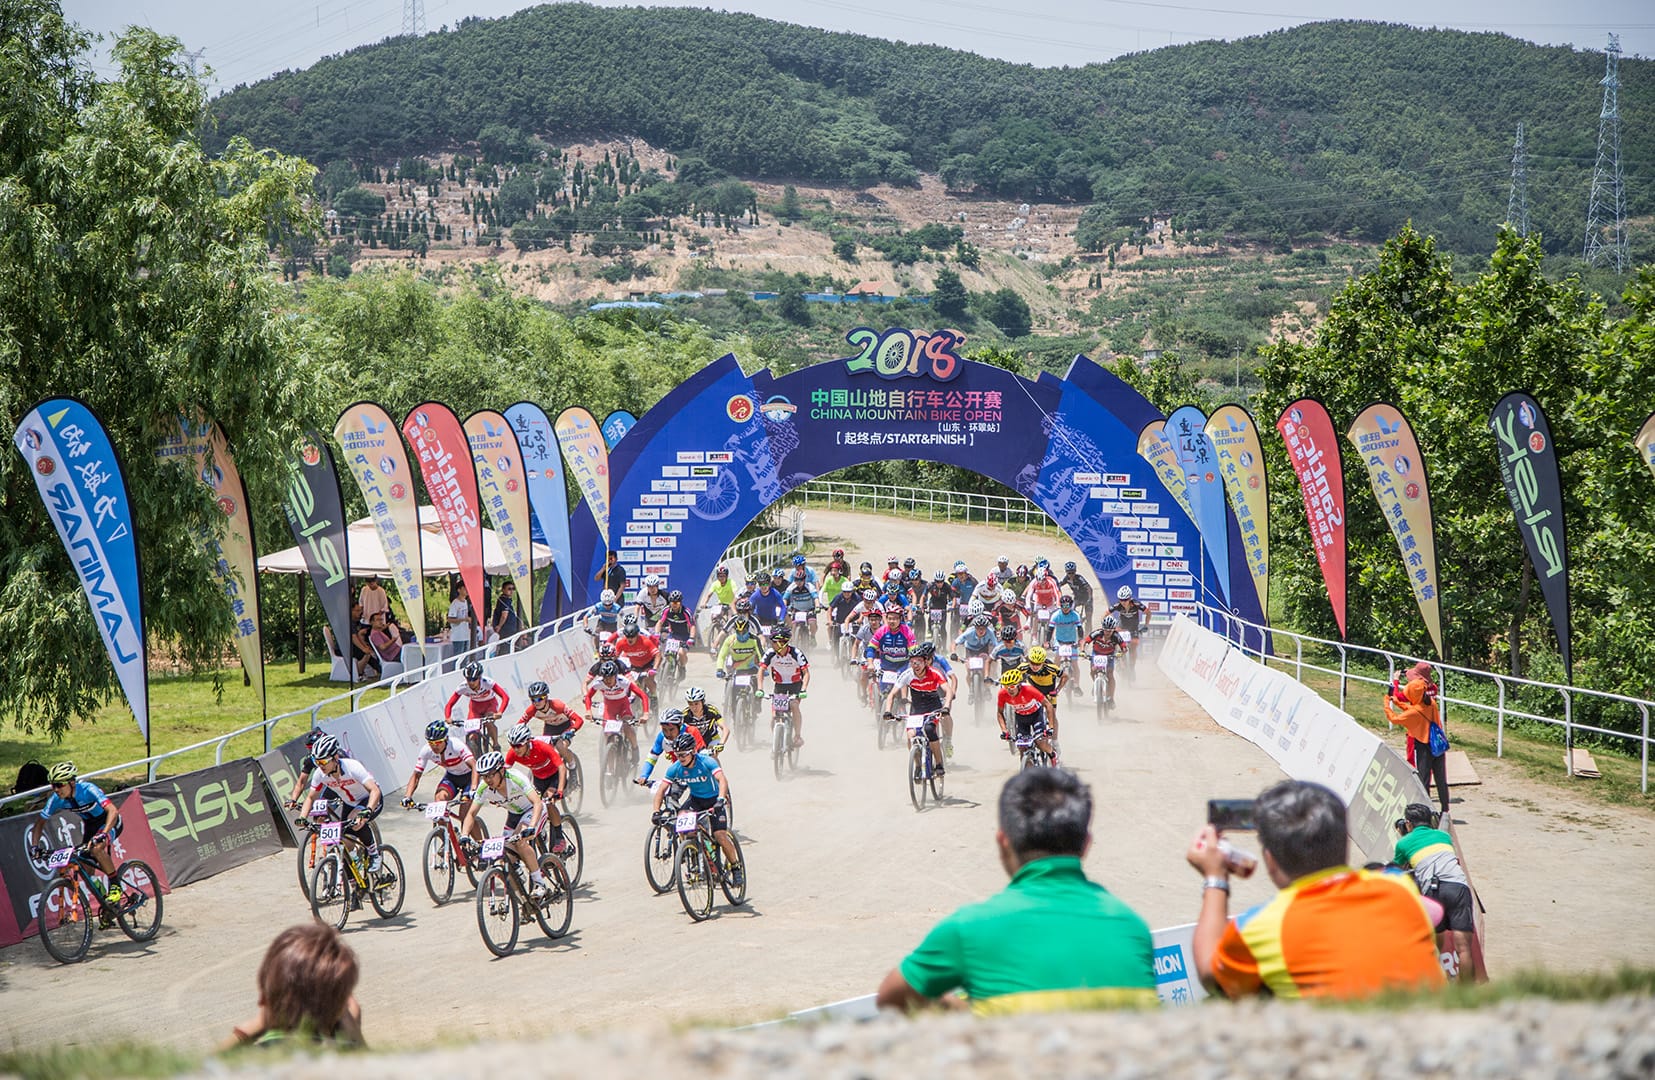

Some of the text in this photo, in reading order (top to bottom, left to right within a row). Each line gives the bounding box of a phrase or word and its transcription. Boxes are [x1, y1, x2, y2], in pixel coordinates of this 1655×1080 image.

[847, 331, 956, 378] 2018
[811, 388, 1002, 409] 中国山地自行车公开赛
[810, 409, 1002, 422] CHINA MOUNTAIN BIKE OPEN
[774, 699, 788, 707] 502
[143, 772, 265, 842] RISK
[677, 817, 695, 827] 573
[320, 828, 340, 840] 501
[484, 840, 503, 851] 548
[50, 852, 69, 863] 604
